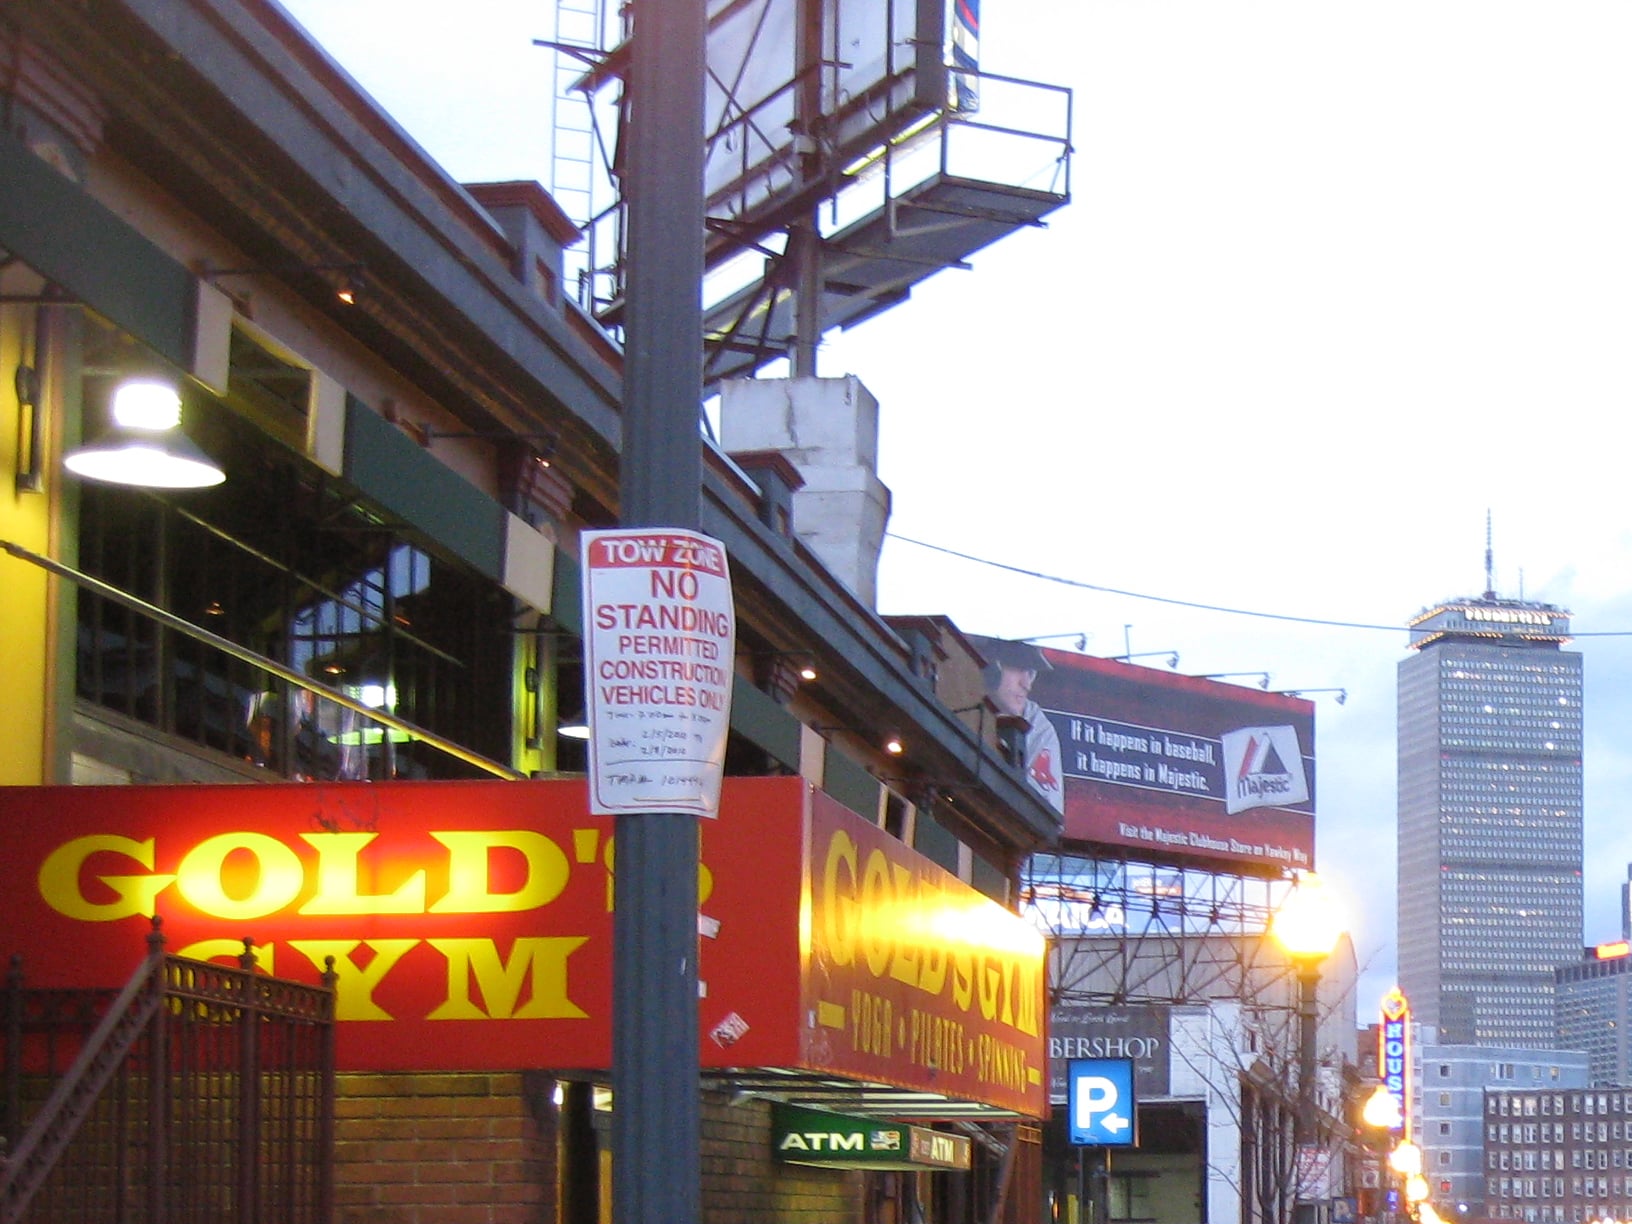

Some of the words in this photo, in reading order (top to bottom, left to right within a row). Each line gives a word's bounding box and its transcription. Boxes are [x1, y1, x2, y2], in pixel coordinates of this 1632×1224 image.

[601, 538, 667, 563] TOW
[672, 539, 721, 573] ZONE
[649, 569, 700, 601] NO
[596, 604, 729, 638] STANDING
[619, 635, 719, 661] PERMITTED
[599, 659, 728, 688] CONSTRUCTION
[601, 684, 697, 706] VEHICLES
[699, 687, 724, 712] ONLY
[1071, 719, 1082, 741] If
[1084, 723, 1096, 744] it
[1098, 724, 1149, 754] happens
[1150, 735, 1162, 756] in
[1077, 751, 1088, 772] it
[1091, 752, 1142, 781] happens
[1144, 762, 1156, 783] in
[1157, 763, 1210, 792] Majestic.
[1237, 776, 1291, 799] Majestic
[1140, 825, 1154, 841] the
[37, 829, 713, 922] GOLD'
[853, 988, 892, 1058] YOGA
[911, 1008, 964, 1076] PILATES
[978, 1033, 1027, 1094] SPINNING
[1049, 1036, 1160, 1059] BERSHOP
[1386, 1022, 1403, 1108] HOUS
[1077, 1076, 1118, 1129] P
[781, 1132, 865, 1151] ATM
[931, 1135, 954, 1163] ATM
